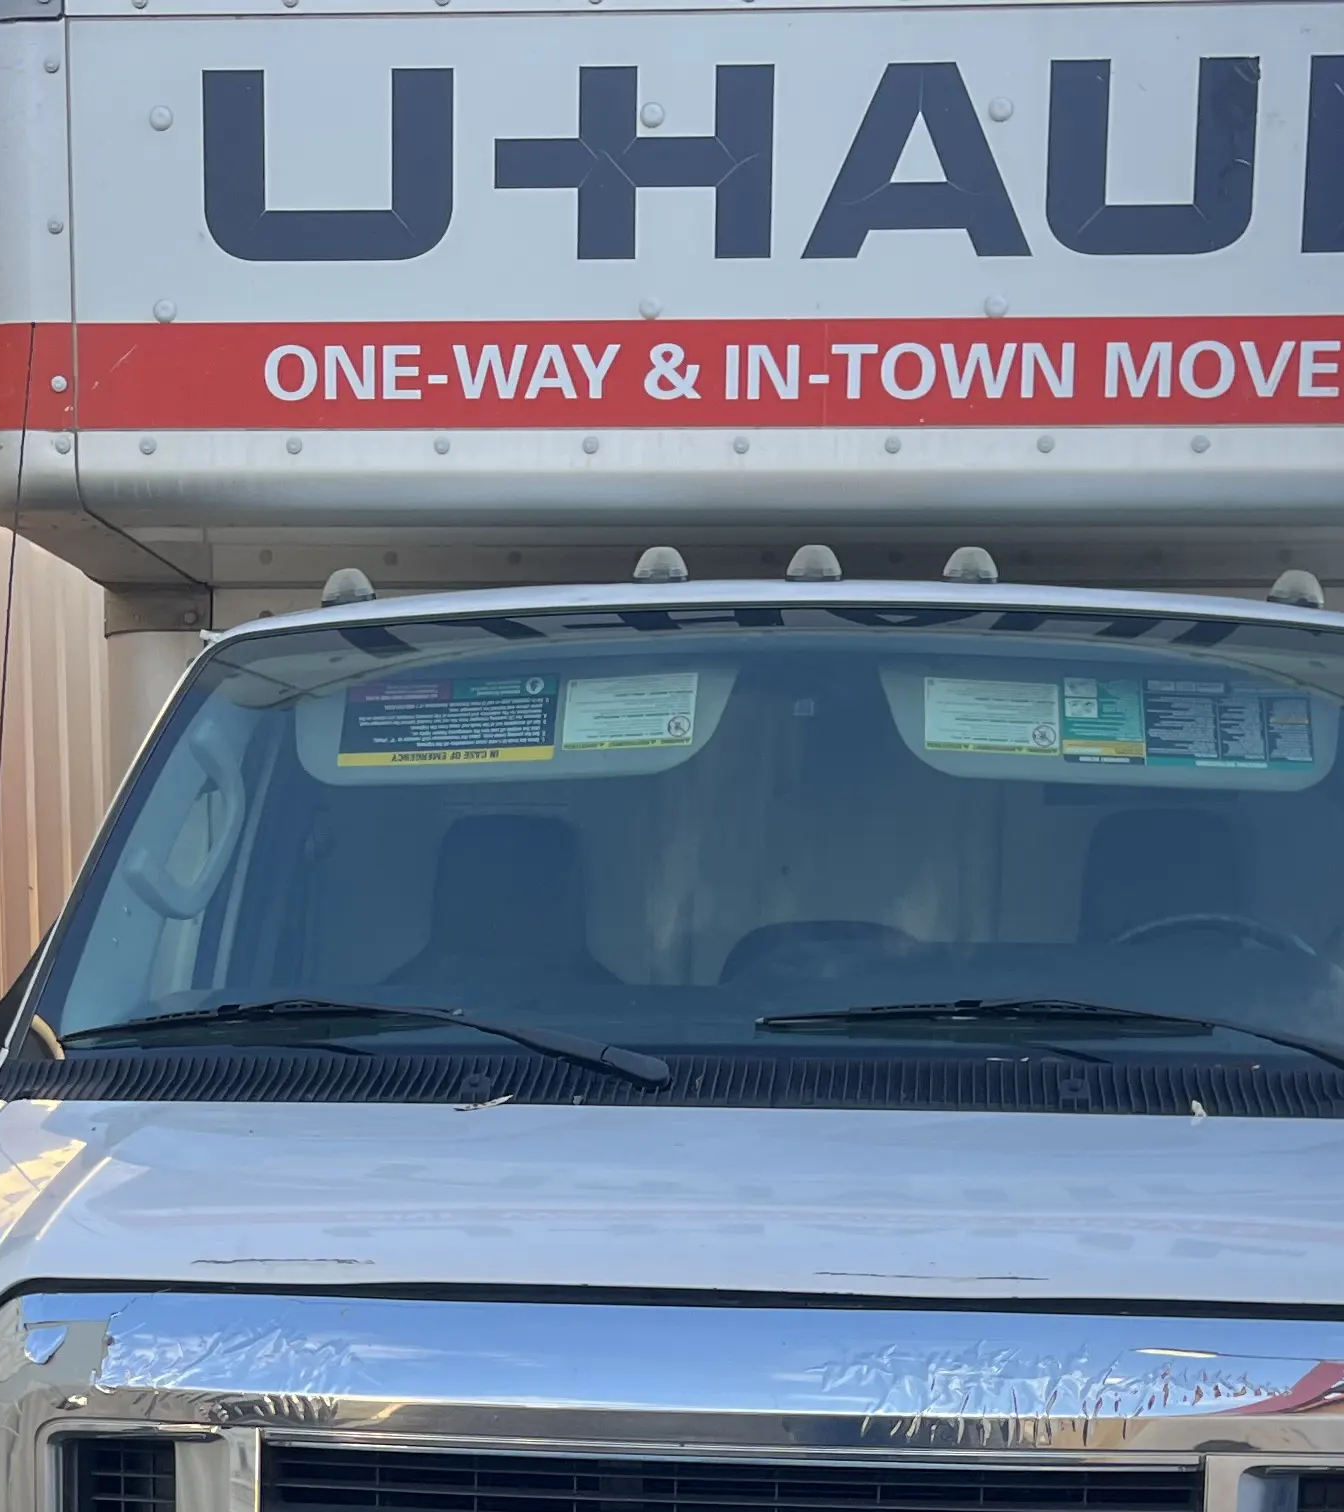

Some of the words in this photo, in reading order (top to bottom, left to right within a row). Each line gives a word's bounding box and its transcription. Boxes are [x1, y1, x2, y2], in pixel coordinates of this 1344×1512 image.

[263, 343, 621, 401] ONE-WAY
[643, 342, 702, 400] &
[725, 341, 1076, 400] IN-TOWN
[391, 751, 447, 762] EMERGENCY
